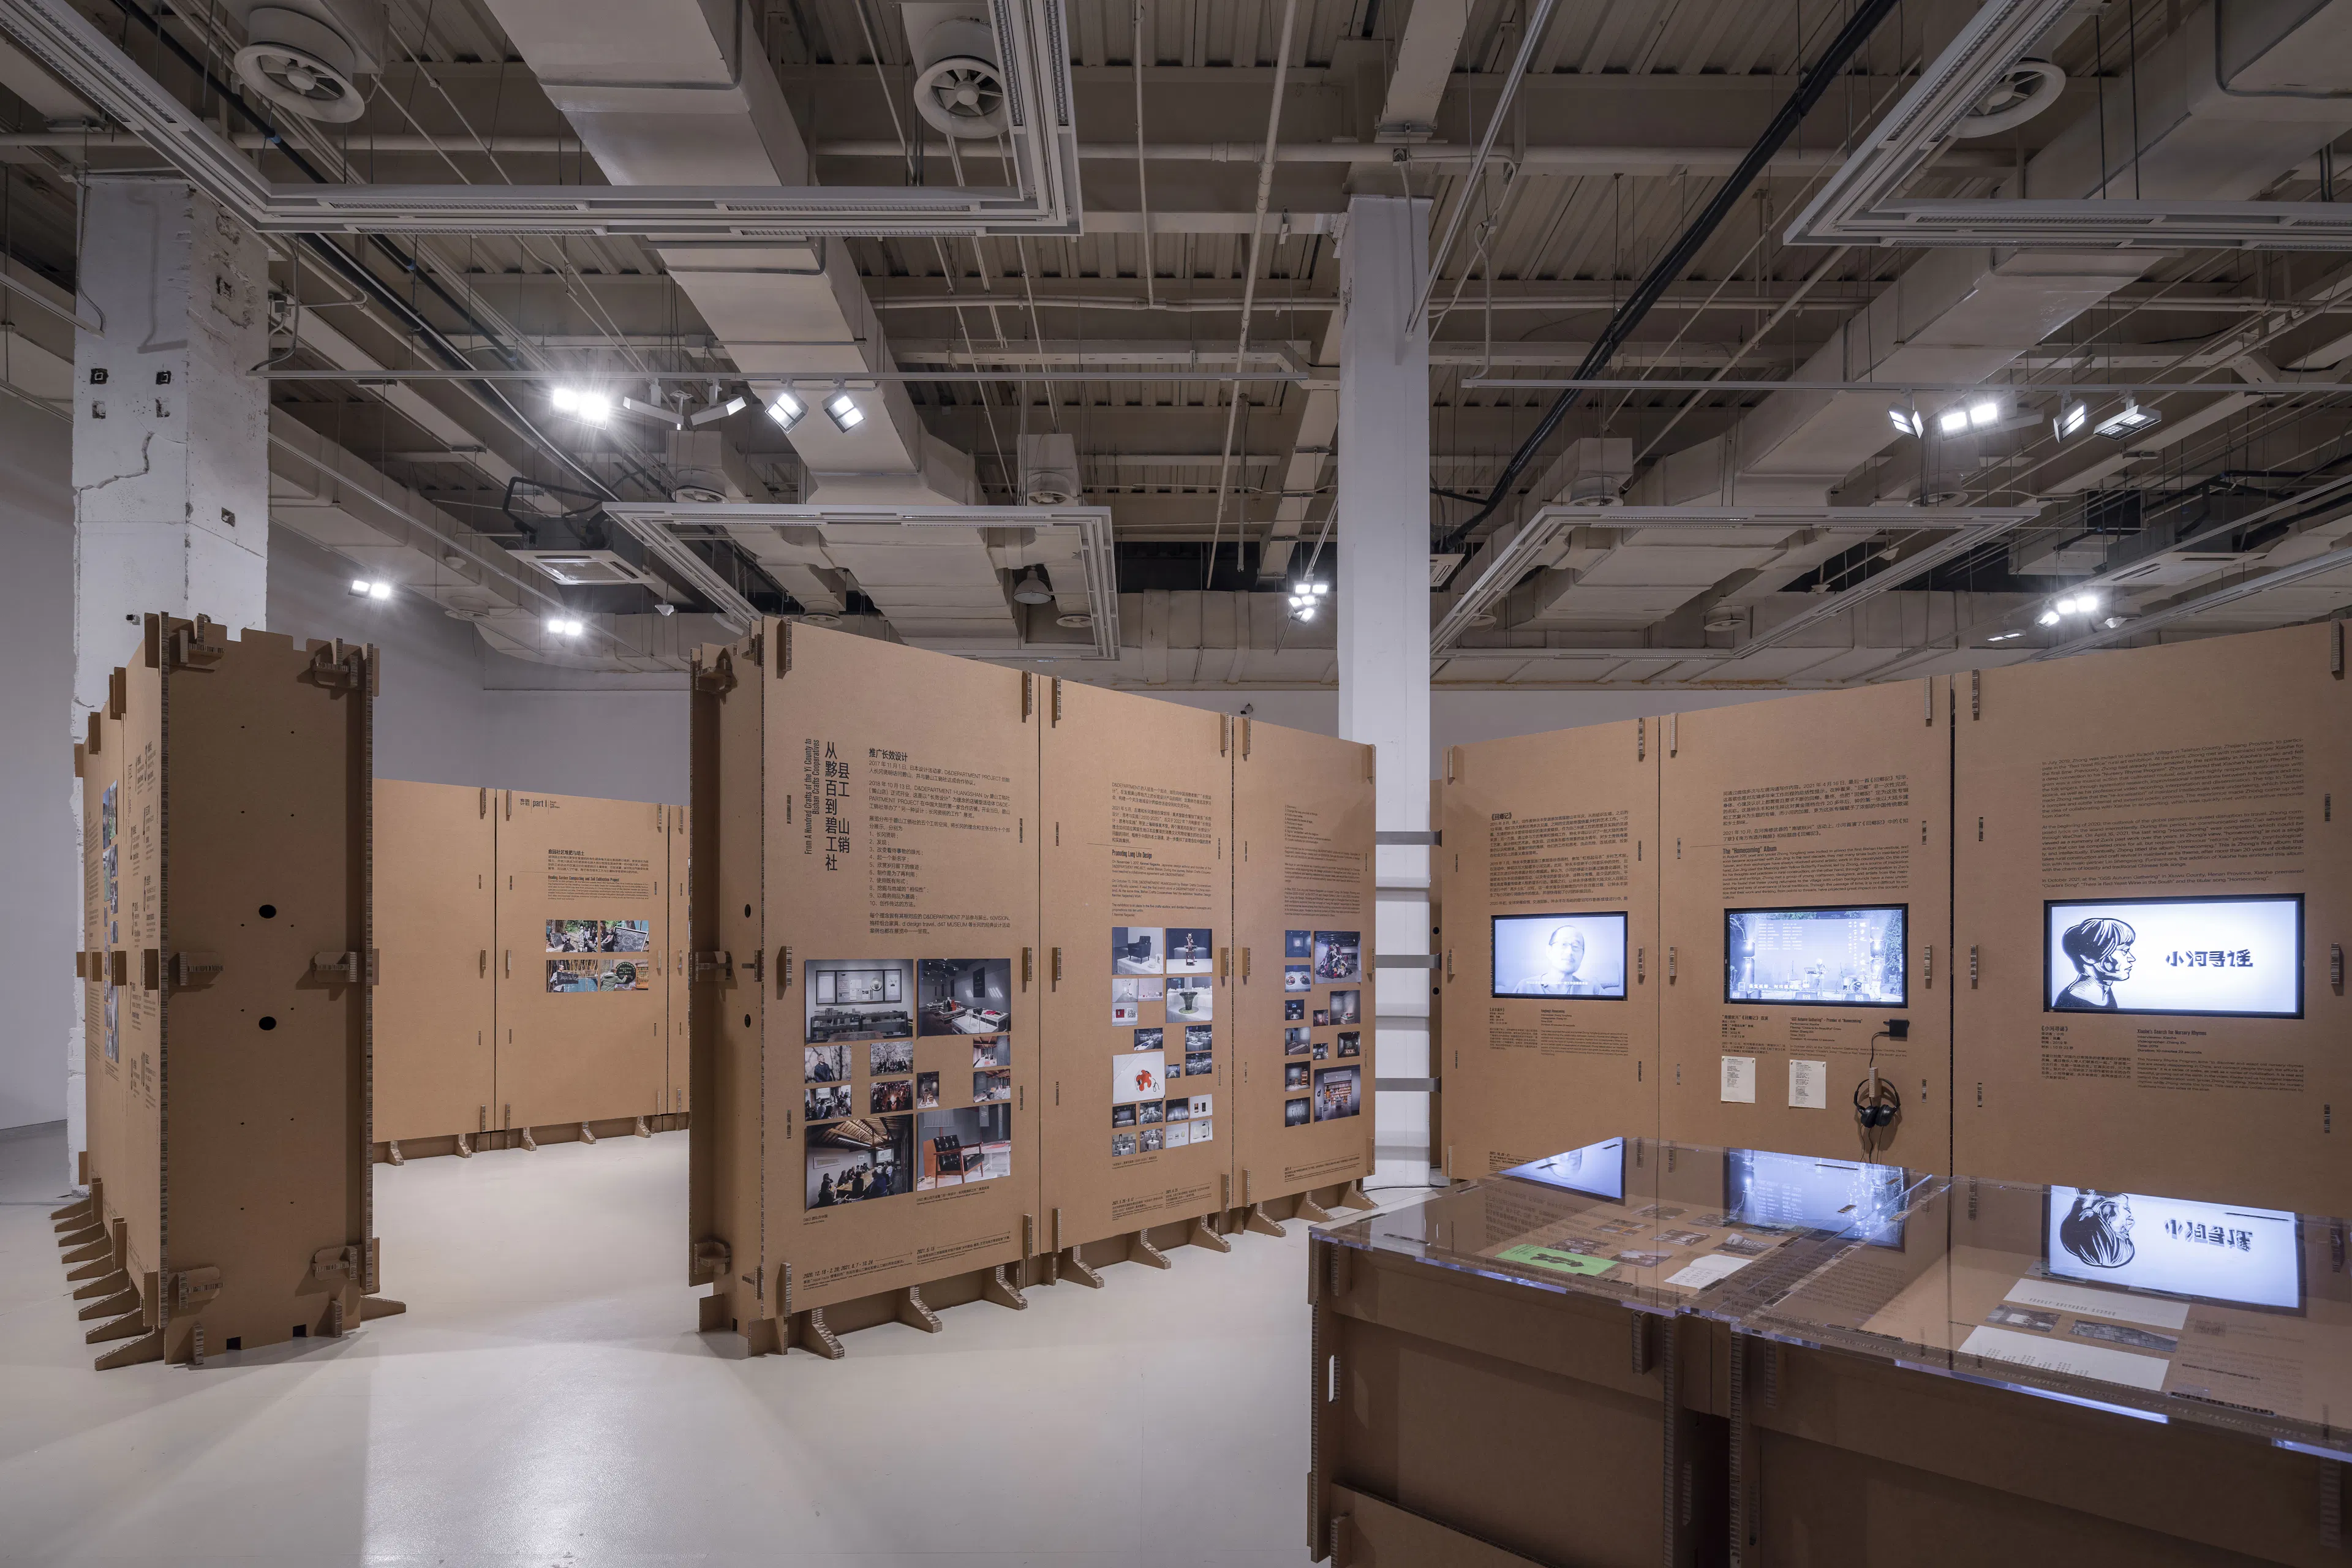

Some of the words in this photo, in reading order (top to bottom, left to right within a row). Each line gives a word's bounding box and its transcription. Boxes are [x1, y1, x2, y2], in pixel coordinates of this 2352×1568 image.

[804, 745, 814, 764] County
[812, 739, 820, 775] Cooperatives
[869, 748, 908, 762] 推广长效设计
[2165, 948, 2254, 968] 小河寻谣
